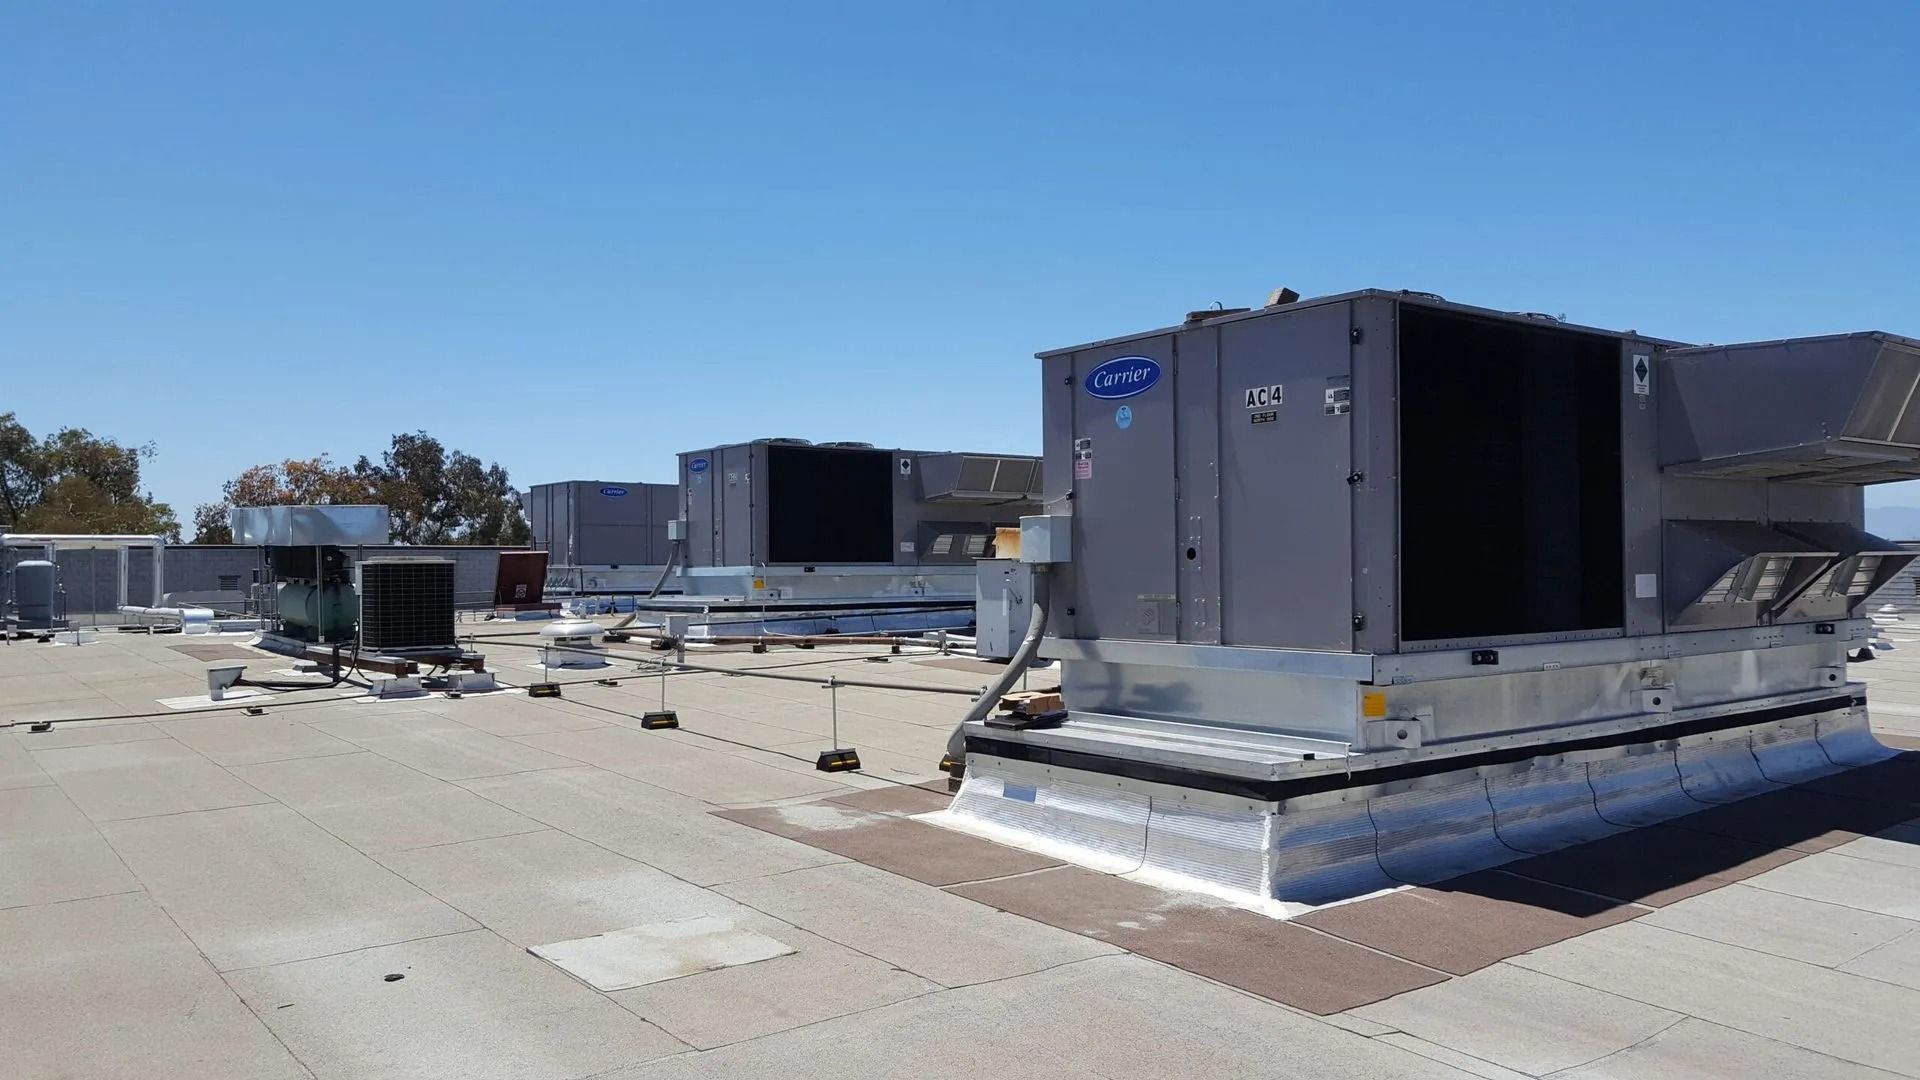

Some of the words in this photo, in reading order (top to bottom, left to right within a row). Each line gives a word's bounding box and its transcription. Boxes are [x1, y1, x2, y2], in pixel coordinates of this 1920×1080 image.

[1094, 366, 1151, 388] Carrier
[1247, 389, 1266, 407] AC
[1272, 387, 1281, 403] 4
